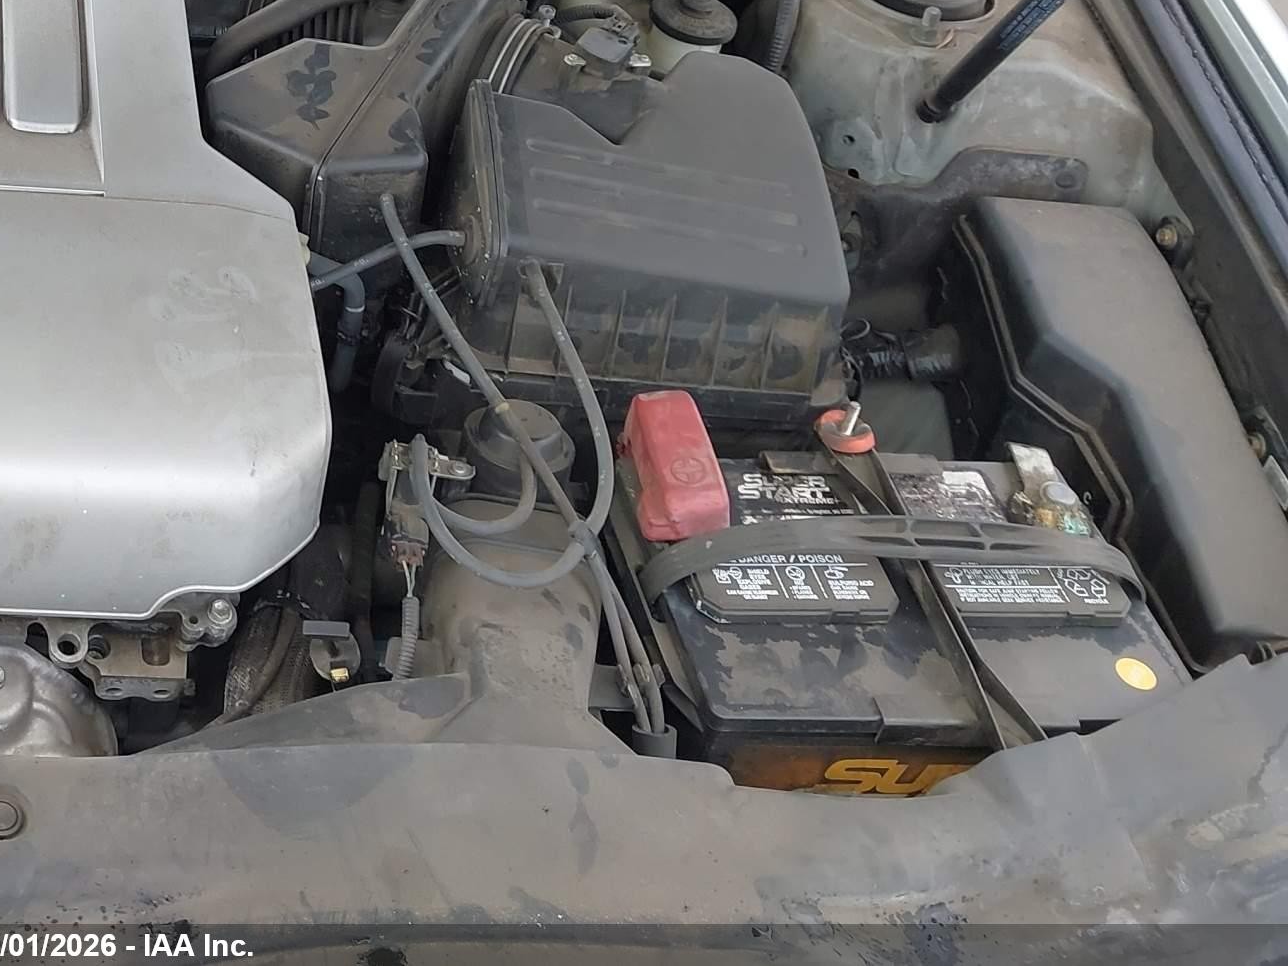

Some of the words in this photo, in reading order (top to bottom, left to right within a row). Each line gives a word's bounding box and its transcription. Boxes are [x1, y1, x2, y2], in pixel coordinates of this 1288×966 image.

[737, 485, 831, 500] START
[798, 554, 844, 564] POISON
[825, 758, 970, 794] SU
